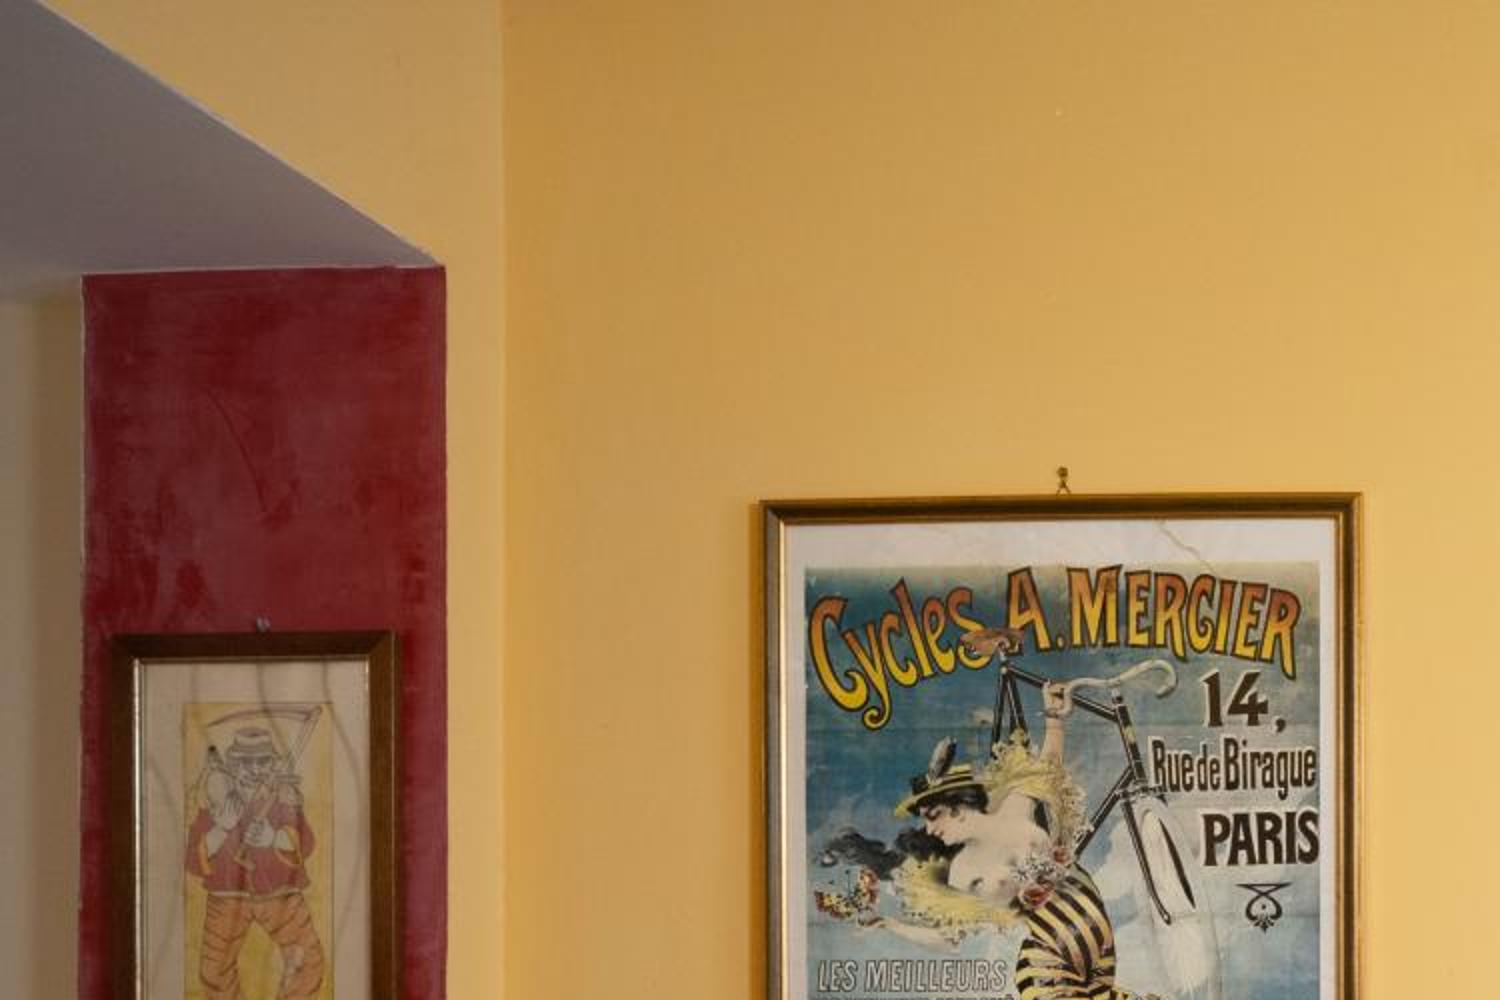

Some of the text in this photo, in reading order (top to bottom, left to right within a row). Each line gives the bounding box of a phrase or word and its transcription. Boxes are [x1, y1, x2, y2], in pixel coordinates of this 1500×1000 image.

[808, 577, 994, 730] Cycles
[1067, 563, 1302, 680] MERCIER
[1201, 670, 1286, 732] 14,
[1151, 737, 1317, 800] Rue de Birague
[1202, 809, 1320, 867] PARIS
[817, 960, 1007, 993] LES MEILLEURS
